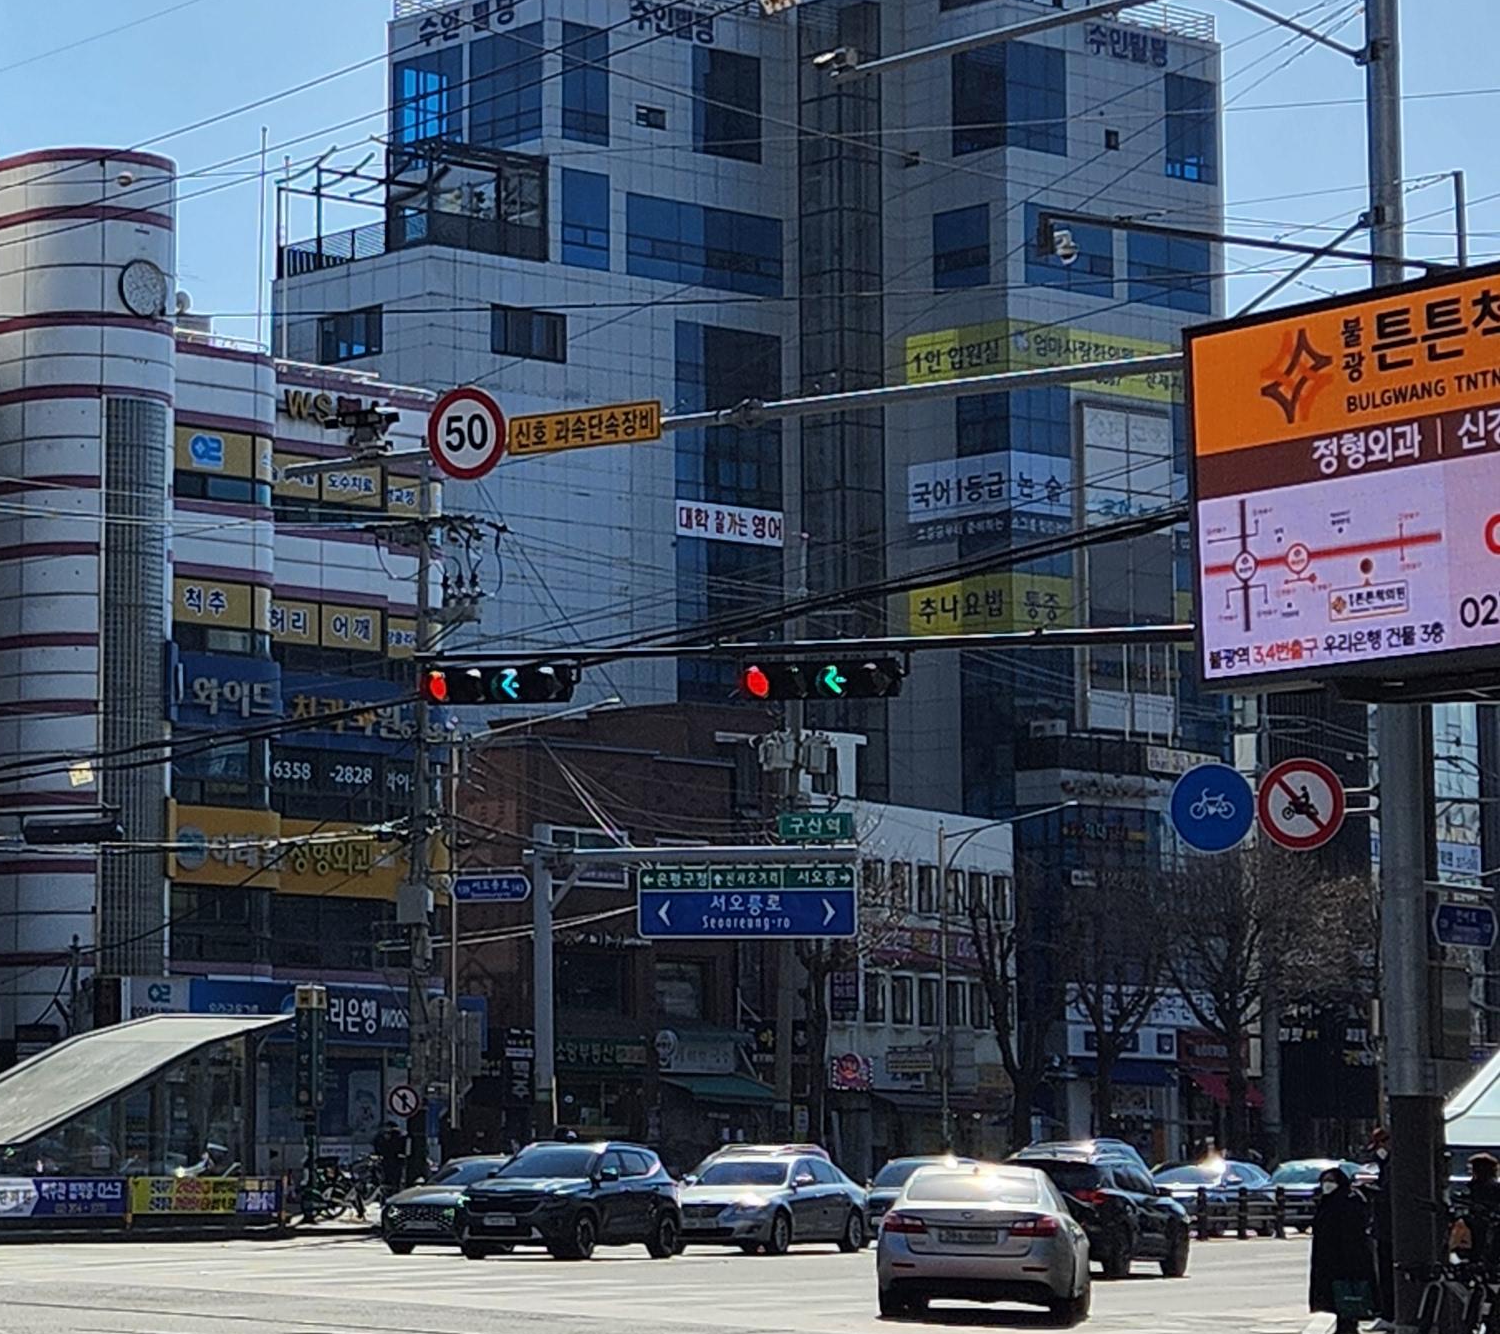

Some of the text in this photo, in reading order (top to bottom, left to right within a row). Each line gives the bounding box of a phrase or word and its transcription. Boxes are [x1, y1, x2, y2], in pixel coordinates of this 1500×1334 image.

[1341, 315, 1366, 384] 불광
[1346, 378, 1446, 414] BULGWANG
[445, 413, 488, 453] 50
[515, 406, 655, 450] 신호 과속단속장비
[1313, 421, 1422, 475] 정형외과
[327, 473, 375, 493] 도수치료
[678, 506, 709, 533] 대학
[751, 513, 783, 542] 영어
[184, 586, 227, 617] 척추
[270, 606, 308, 635] 허리
[332, 612, 372, 642] 어깨
[1209, 621, 1445, 671] 불광역 3,4번출구 우리은행 건물 3층
[273, 759, 312, 781] 6358
[329, 763, 374, 785] -2828
[789, 817, 841, 835] 구산역
[656, 871, 708, 888] 은평구청
[797, 870, 838, 888] 서오릉
[709, 894, 783, 916] 서오릉로
[701, 915, 791, 932] Seooreung-ro
[326, 997, 380, 1036] 리은행
